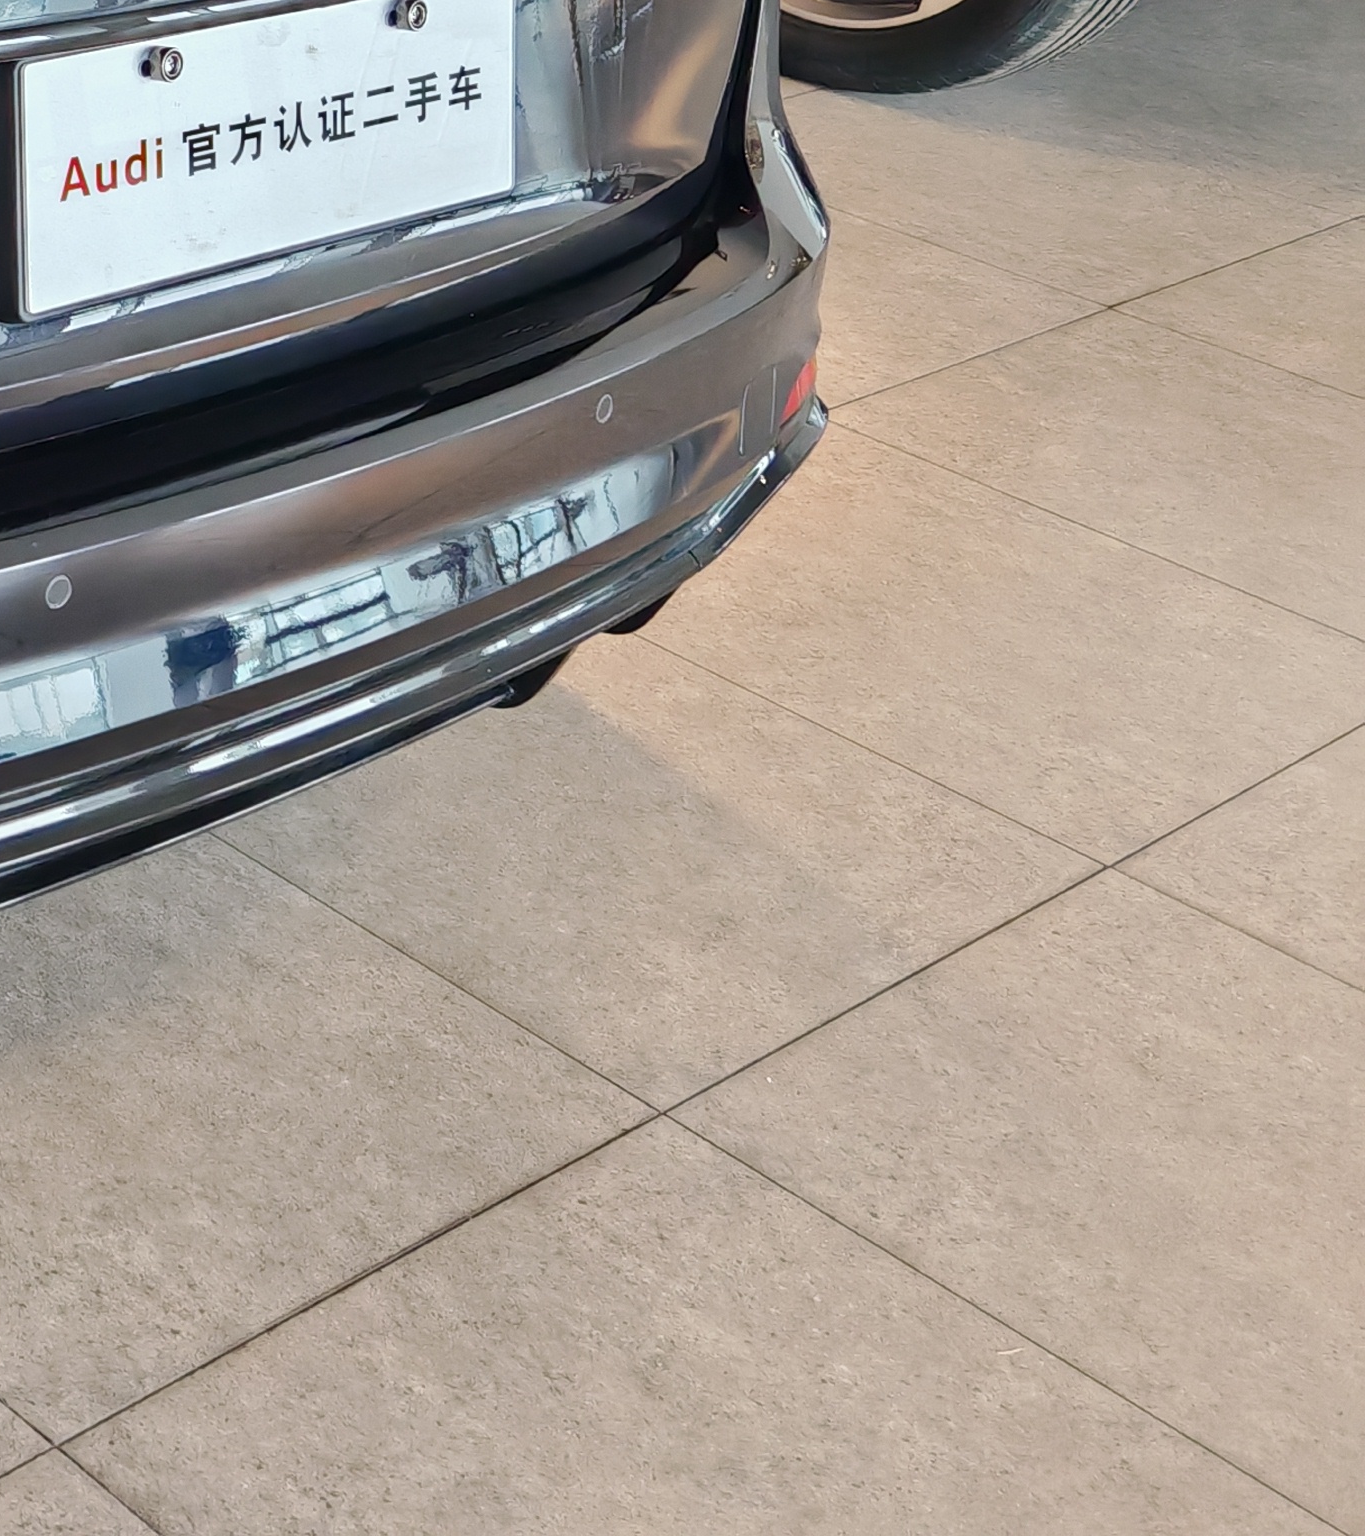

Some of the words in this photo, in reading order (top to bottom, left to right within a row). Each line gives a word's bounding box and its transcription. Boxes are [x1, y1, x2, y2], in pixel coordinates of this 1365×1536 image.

[60, 137, 164, 202] Audi
[181, 65, 484, 177] 官方认证二手车
